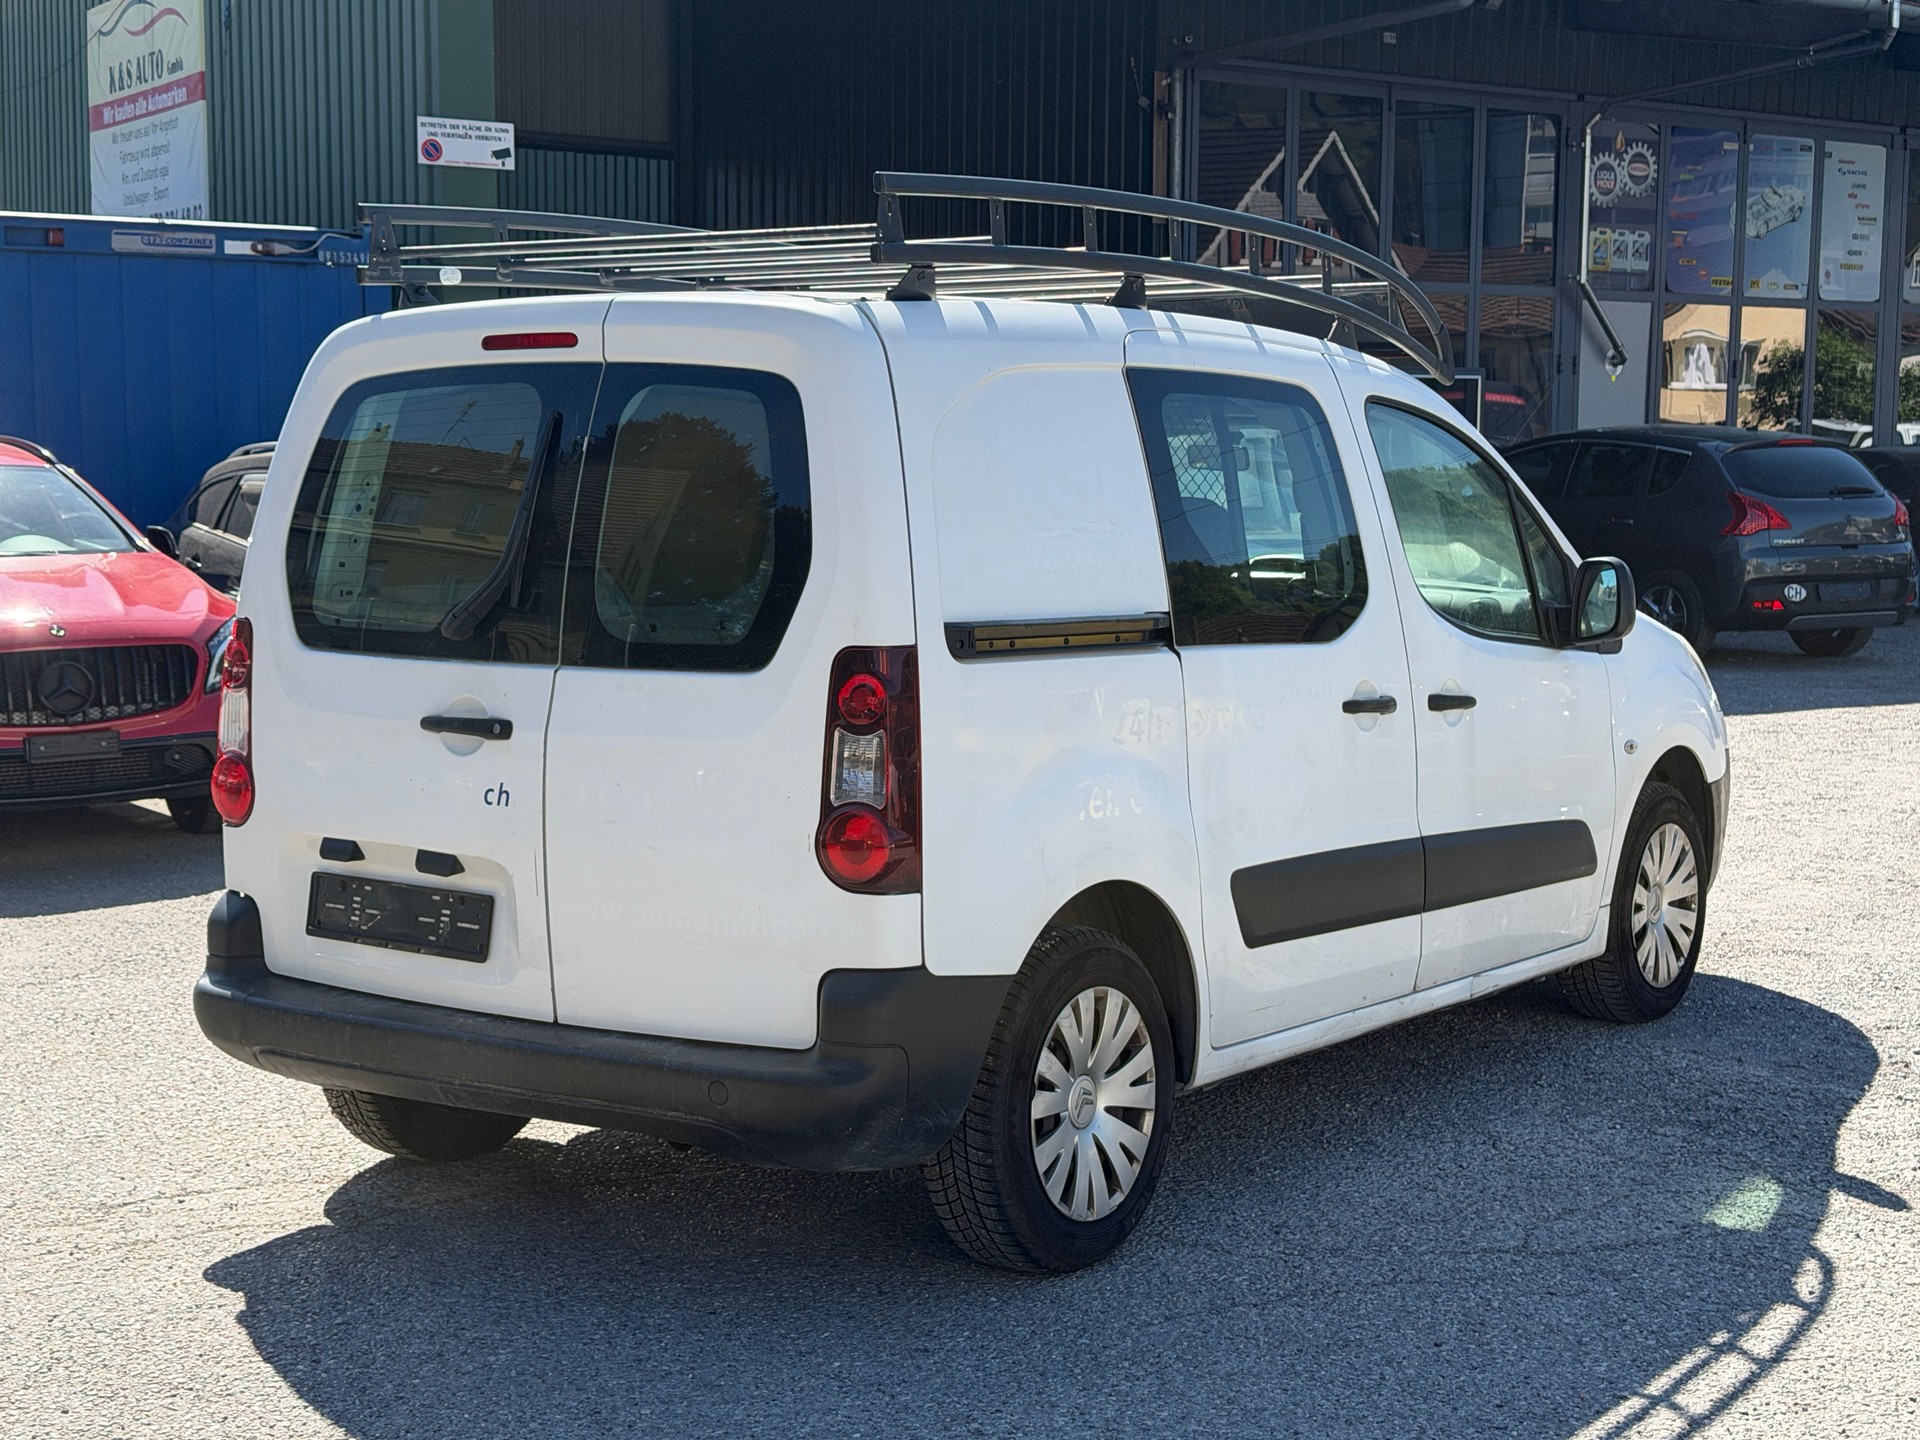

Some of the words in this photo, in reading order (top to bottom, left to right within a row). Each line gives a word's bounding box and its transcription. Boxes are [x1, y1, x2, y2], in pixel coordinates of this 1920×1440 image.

[109, 59, 133, 94] K&S
[135, 48, 164, 87] AUTO
[103, 106, 114, 126] Wir
[114, 100, 135, 122] kaufen
[135, 96, 147, 117] alle
[147, 86, 188, 113] Automarken
[420, 121, 447, 129] BETRETEN
[1596, 170, 1615, 179] LIQUI
[1596, 179, 1615, 189] MOLY
[165, 236, 214, 247] CONTAINEX
[1711, 278, 1733, 287] TEXTA
[1773, 537, 1805, 545] PEUGEOT
[1787, 585, 1802, 600] CH
[483, 782, 511, 808] ch
